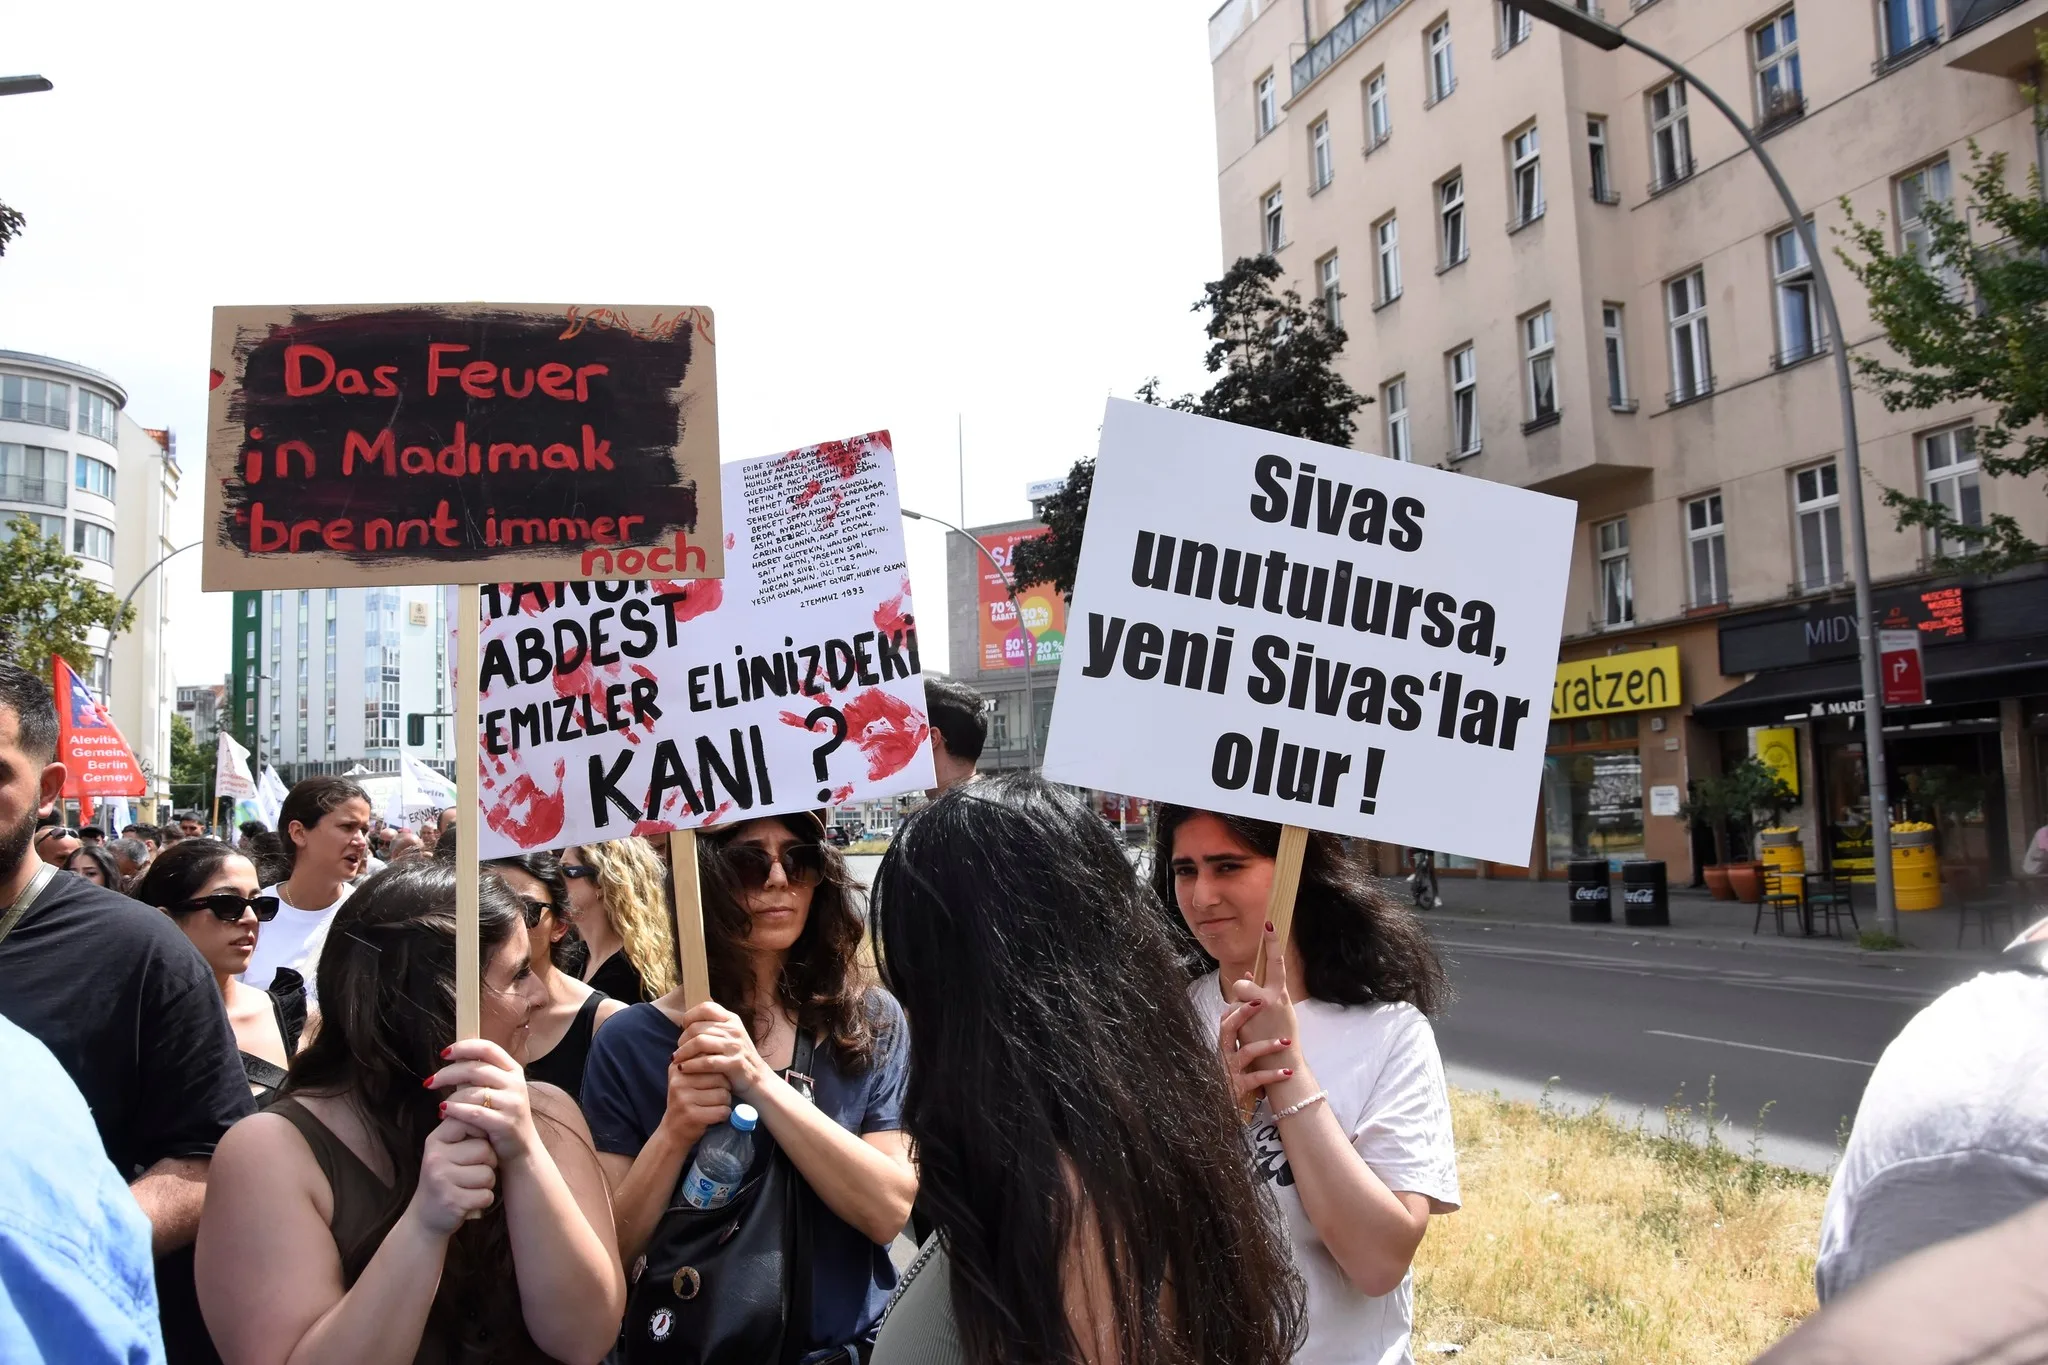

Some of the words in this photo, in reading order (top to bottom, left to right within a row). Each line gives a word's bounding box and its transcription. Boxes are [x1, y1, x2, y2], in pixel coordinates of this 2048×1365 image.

[283, 344, 400, 398] Das
[427, 343, 609, 403] Feuer
[246, 427, 316, 484] in
[249, 500, 460, 553] brennt
[486, 508, 645, 547] immer
[1250, 454, 1426, 553] Sivas
[581, 531, 706, 577] noch
[752, 556, 782, 569] HASRET
[759, 580, 789, 595] NURCAN
[1131, 530, 1507, 667] unutulursa,
[479, 590, 687, 693] ABDEST
[991, 611, 1018, 622] RABATT
[1006, 649, 1033, 659] RABAT
[1081, 612, 1235, 695] yeni
[72, 747, 128, 757] Gemein
[82, 772, 134, 783] Cemevi
[87, 760, 128, 770] Berlin
[588, 724, 774, 829] KANI
[1211, 727, 1352, 809] olur
